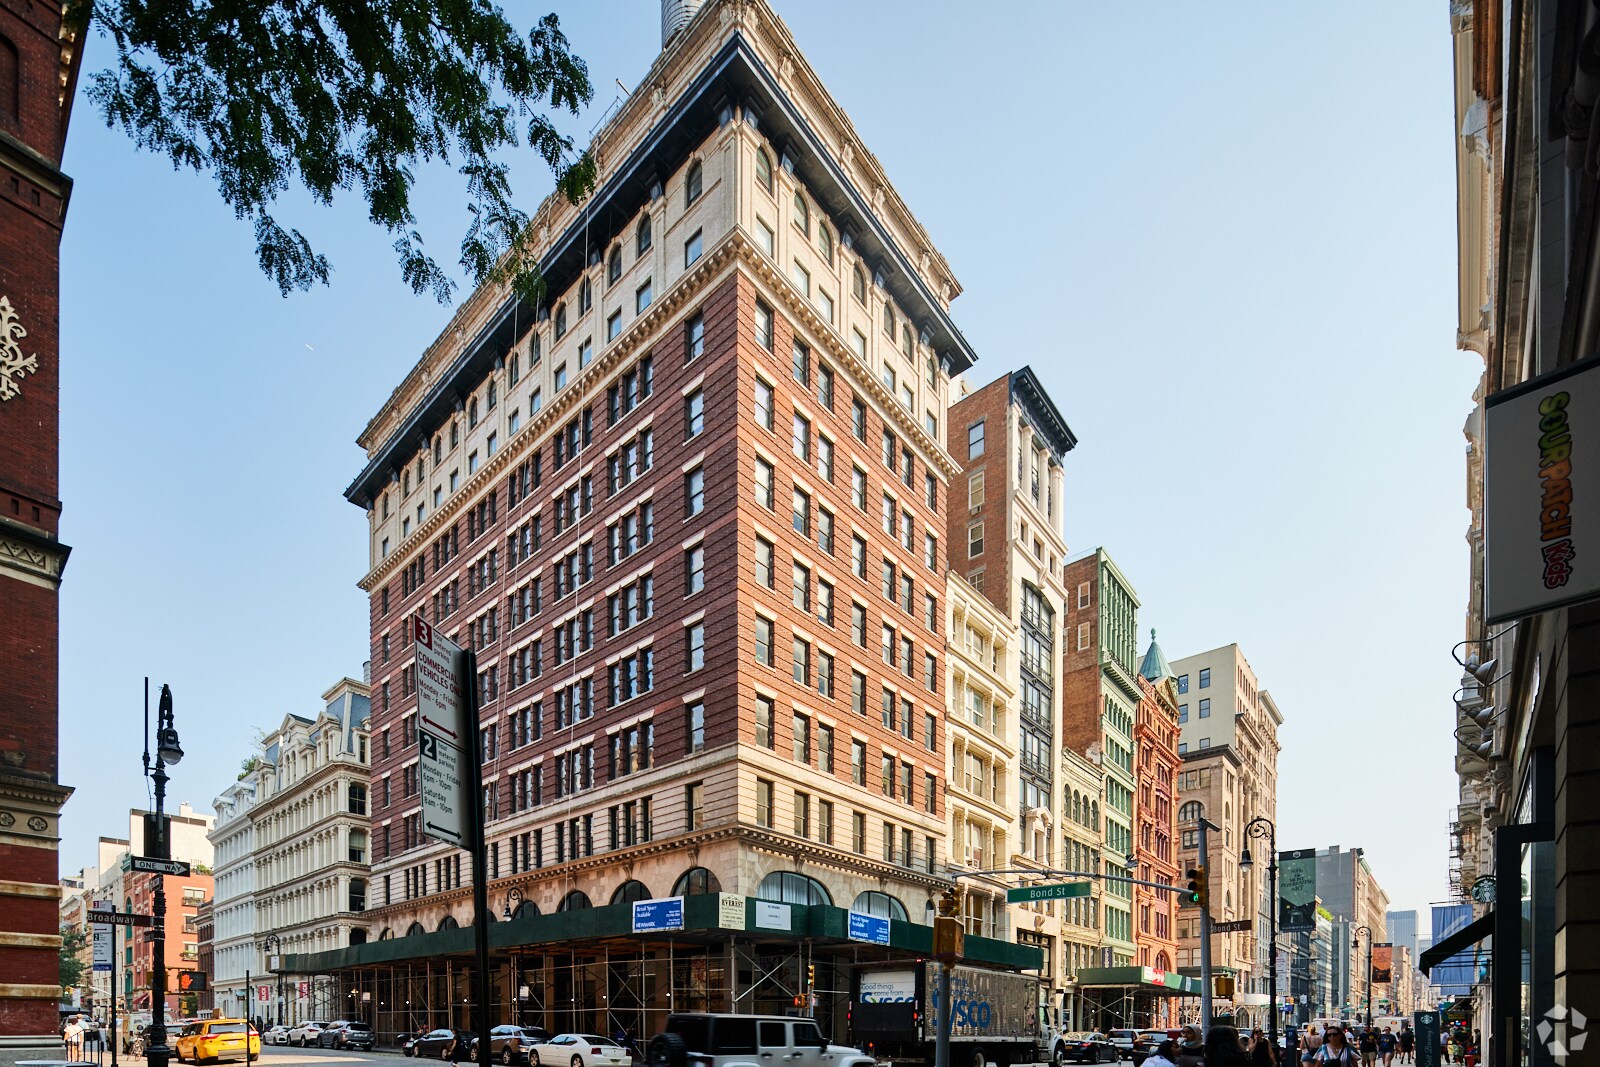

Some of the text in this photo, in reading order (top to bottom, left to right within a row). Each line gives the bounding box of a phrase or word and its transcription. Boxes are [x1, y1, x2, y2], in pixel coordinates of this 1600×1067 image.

[1538, 391, 1577, 590] SOUR PATCH Kids
[419, 621, 429, 644] 3
[433, 639, 452, 657] metered
[433, 648, 450, 664] parking
[418, 650, 458, 684] COMMERCIAL
[418, 662, 449, 690] VEHICLES
[419, 678, 439, 697] Monday
[442, 693, 458, 709] Friday
[420, 688, 432, 701] 7am
[435, 698, 447, 711] 6pm
[423, 734, 433, 758] 2
[438, 750, 457, 764] metered
[438, 758, 455, 772] parking
[422, 761, 442, 779] Monday
[446, 773, 461, 787] Friday
[423, 772, 435, 784] 6pm
[439, 779, 452, 791] 10pm
[423, 786, 447, 803] Saturday
[424, 796, 436, 808] 8am
[440, 802, 453, 814] 10pm
[139, 861, 182, 873] ONE WAY
[1030, 887, 1066, 899] Bond St
[721, 899, 743, 908] EVEREST
[87, 912, 135, 925] Broadway
[850, 930, 869, 938] NEWMARK
[1211, 923, 1241, 933] Bond St
[877, 983, 894, 991] things
